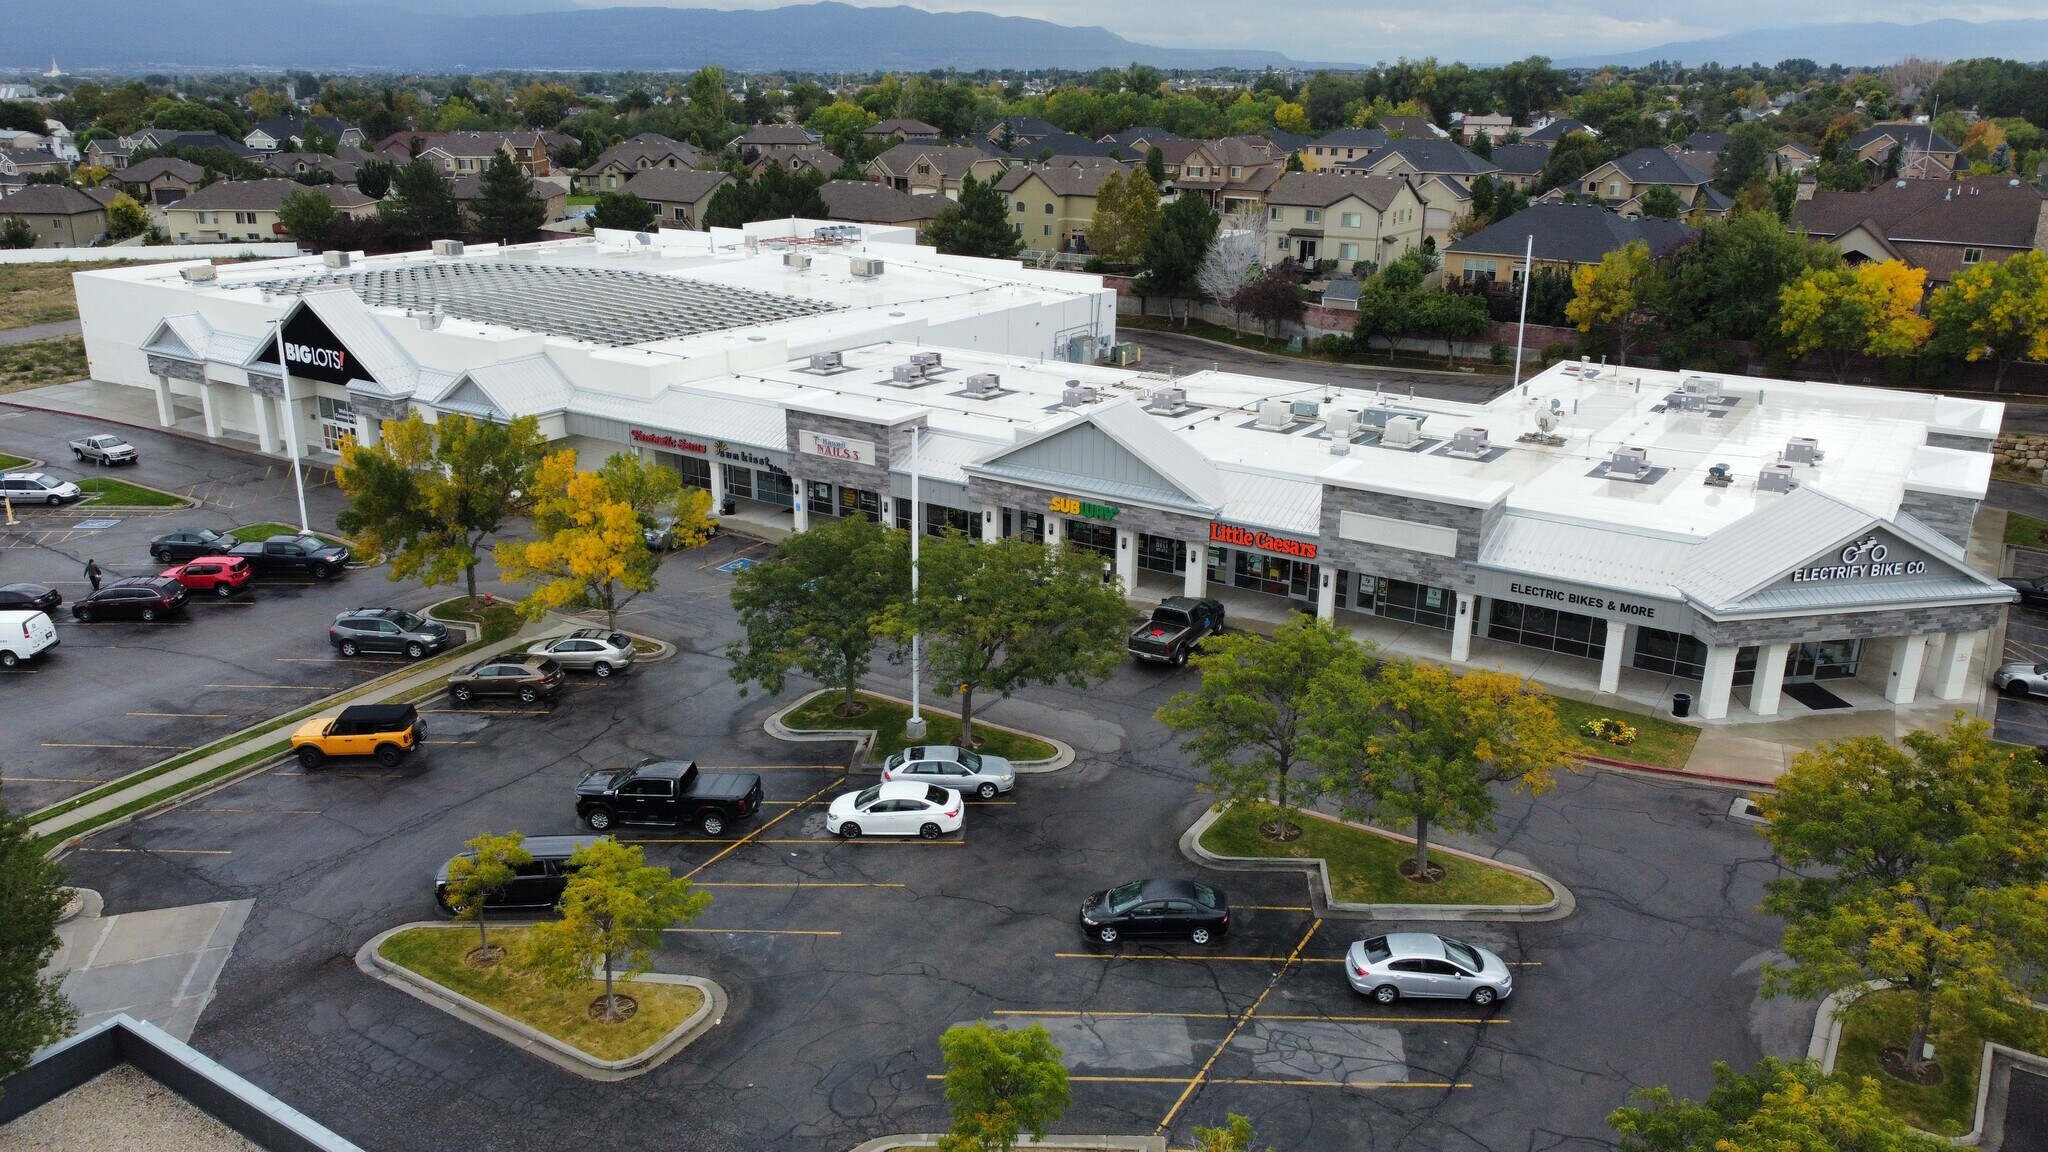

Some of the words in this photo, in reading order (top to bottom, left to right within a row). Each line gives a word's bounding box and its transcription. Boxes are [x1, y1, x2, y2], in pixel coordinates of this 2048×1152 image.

[285, 342, 312, 363] BIG
[817, 444, 851, 460] NAILS
[852, 450, 860, 460] 3
[1049, 496, 1120, 521] SUBWAY
[1210, 522, 1254, 547] Little
[1255, 531, 1318, 559] Caesars
[1793, 564, 1868, 582] ELECTRIFY
[1869, 562, 1904, 577] BIKE
[1906, 560, 1929, 575] CO.
[1510, 582, 1565, 601] ELECTRIC
[1568, 593, 1604, 608] BIKES
[1607, 600, 1616, 611] &
[1619, 602, 1656, 618] MORE
